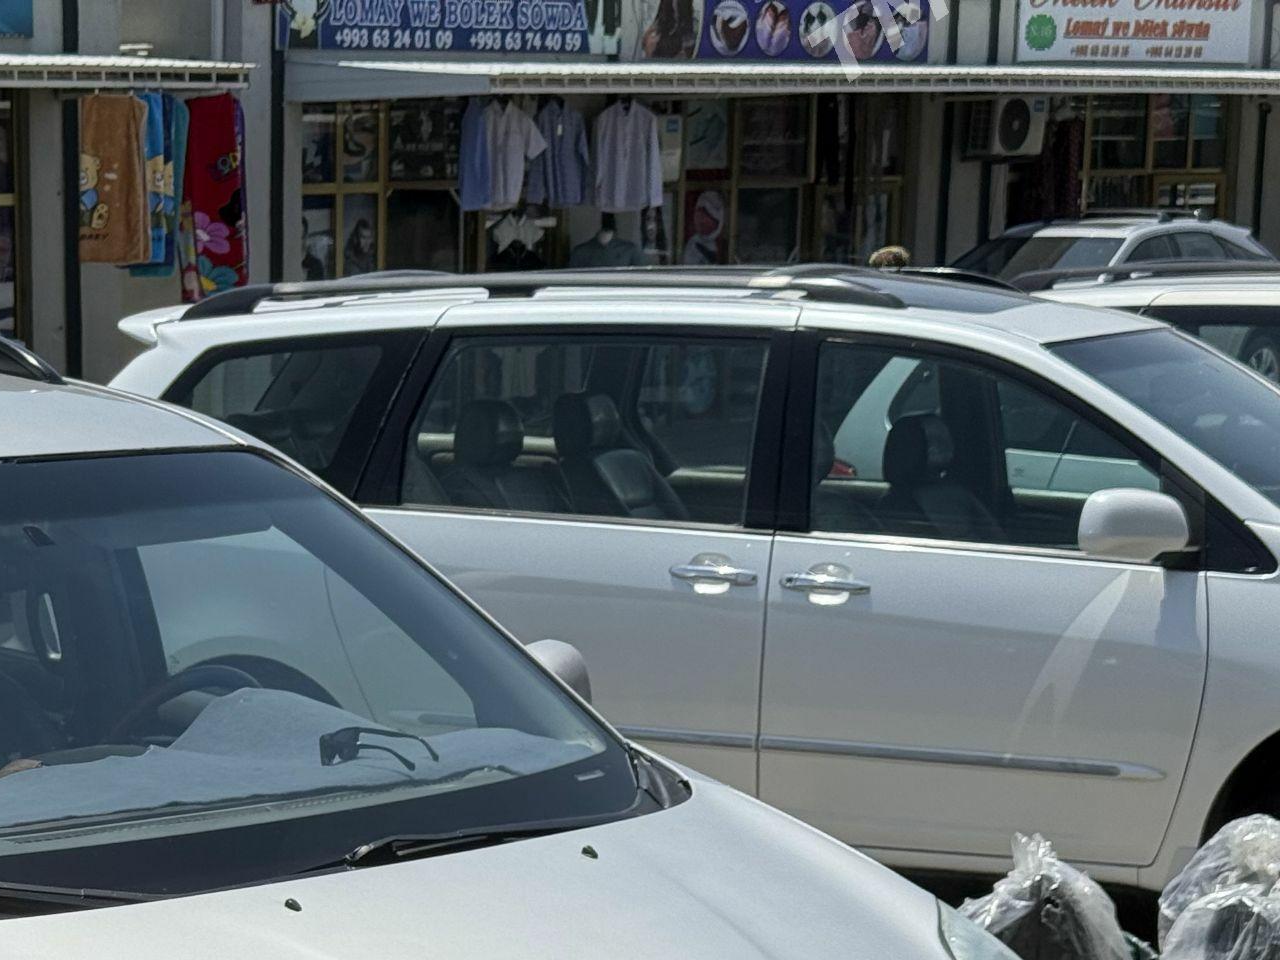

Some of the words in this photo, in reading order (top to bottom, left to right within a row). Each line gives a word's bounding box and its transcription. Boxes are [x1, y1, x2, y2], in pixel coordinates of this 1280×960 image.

[408, 0, 441, 28] WE
[335, 27, 369, 48] +993
[372, 28, 390, 48] 63
[393, 29, 412, 49] 24
[414, 29, 431, 49] 01
[435, 30, 453, 49] 09
[470, 30, 502, 50] +993
[505, 32, 520, 50] 63
[524, 32, 542, 51] 74
[544, 32, 563, 51] 40
[564, 33, 582, 52] 59
